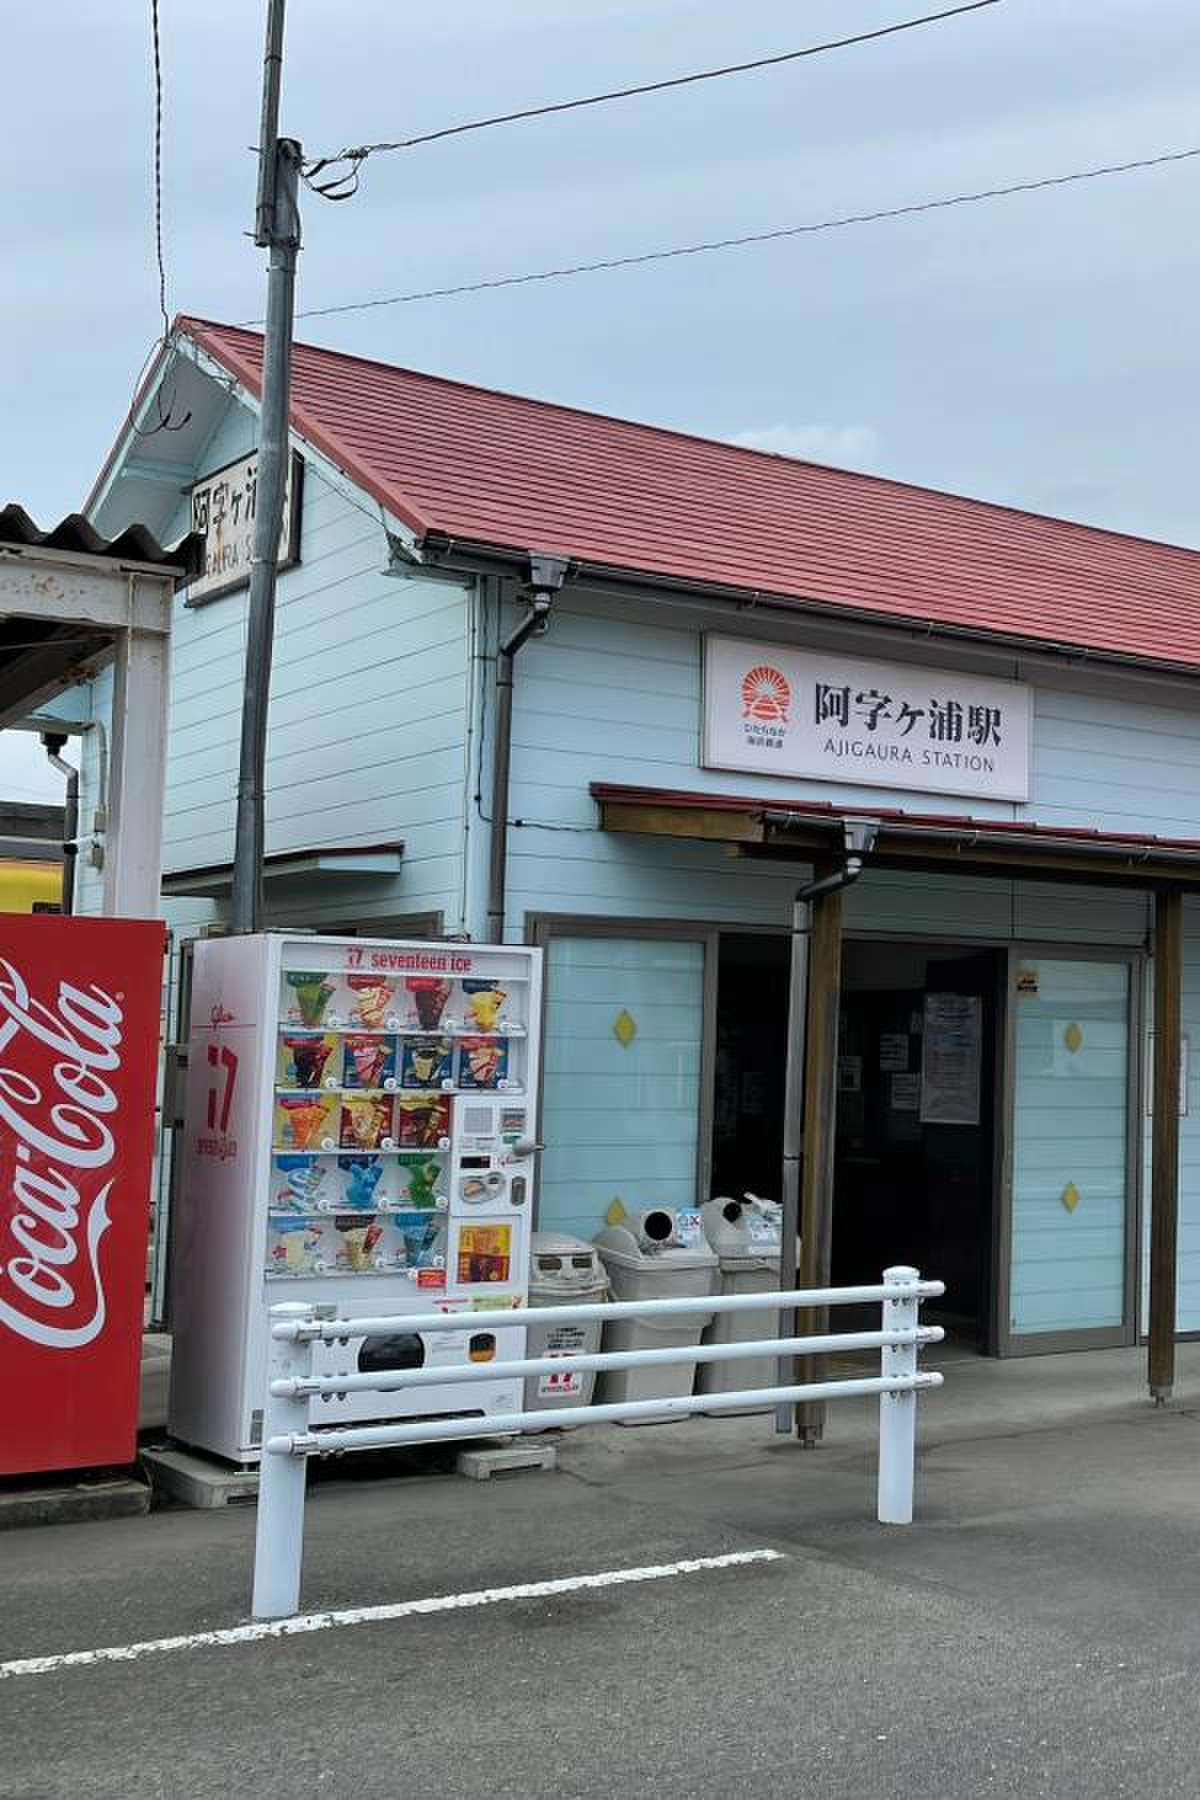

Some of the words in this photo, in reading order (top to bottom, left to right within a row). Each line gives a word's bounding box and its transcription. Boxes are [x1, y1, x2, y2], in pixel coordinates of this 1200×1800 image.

[824, 738, 912, 763] AJIGAURA
[922, 750, 994, 772] STATION
[371, 952, 448, 971] seventeen
[450, 951, 472, 971] ice
